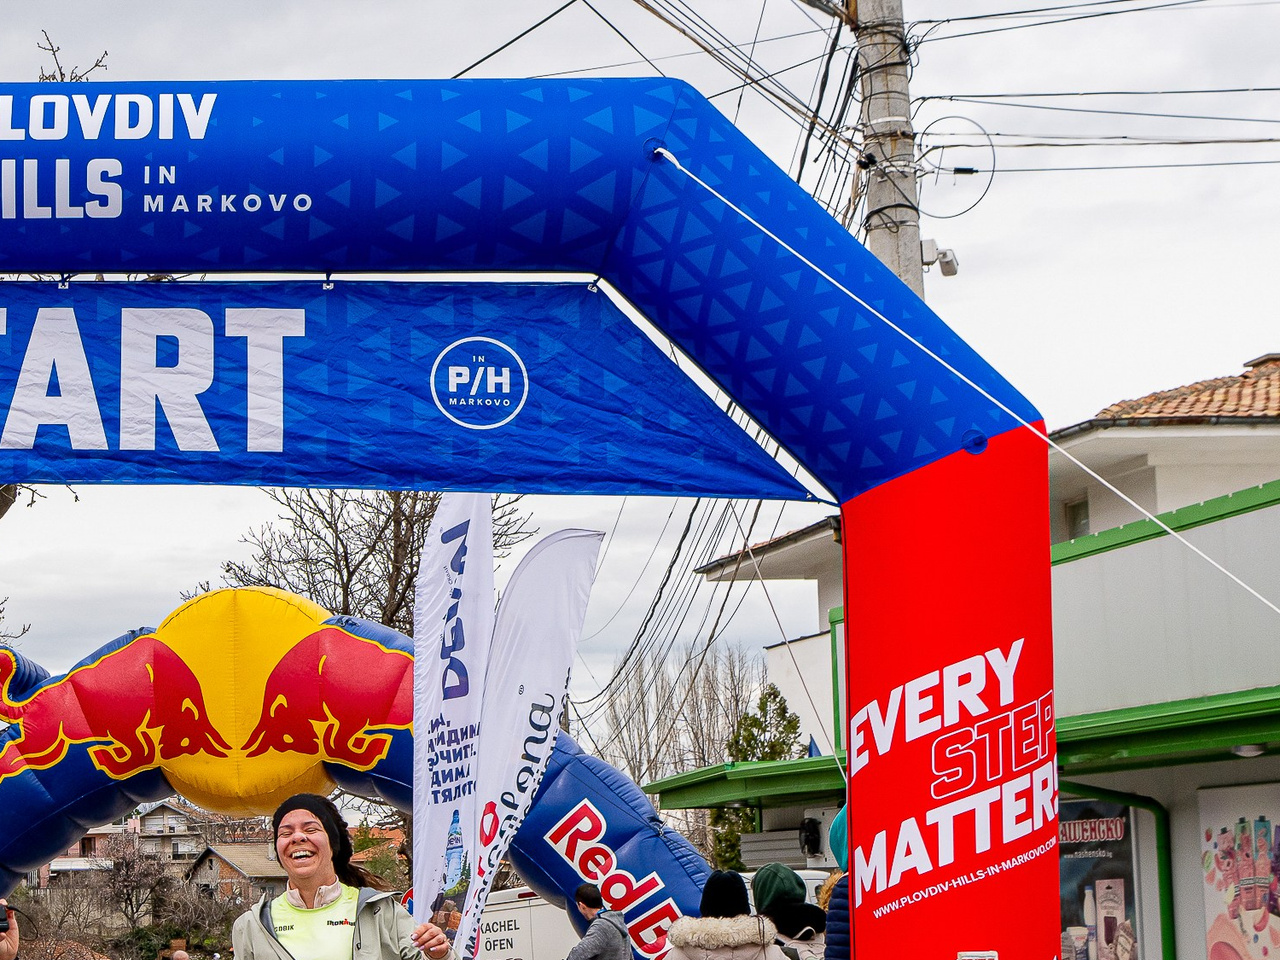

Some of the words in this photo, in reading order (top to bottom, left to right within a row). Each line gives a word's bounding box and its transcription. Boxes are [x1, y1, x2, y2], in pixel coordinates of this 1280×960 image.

[144, 165, 177, 184] IN
[144, 194, 313, 213] MARKOVO
[472, 355, 485, 363] IN
[448, 366, 511, 396] P/H
[449, 398, 511, 407] MARKOVO
[850, 637, 1025, 778] EVERY
[930, 689, 1056, 800] STEP
[1059, 817, 1125, 844] АШЕНСКО
[547, 802, 660, 911] Red
[872, 835, 1057, 920] WWW.PLOVDIV-HILLS-IN-MARKOVO.COM
[484, 938, 514, 952] ÖFEN
